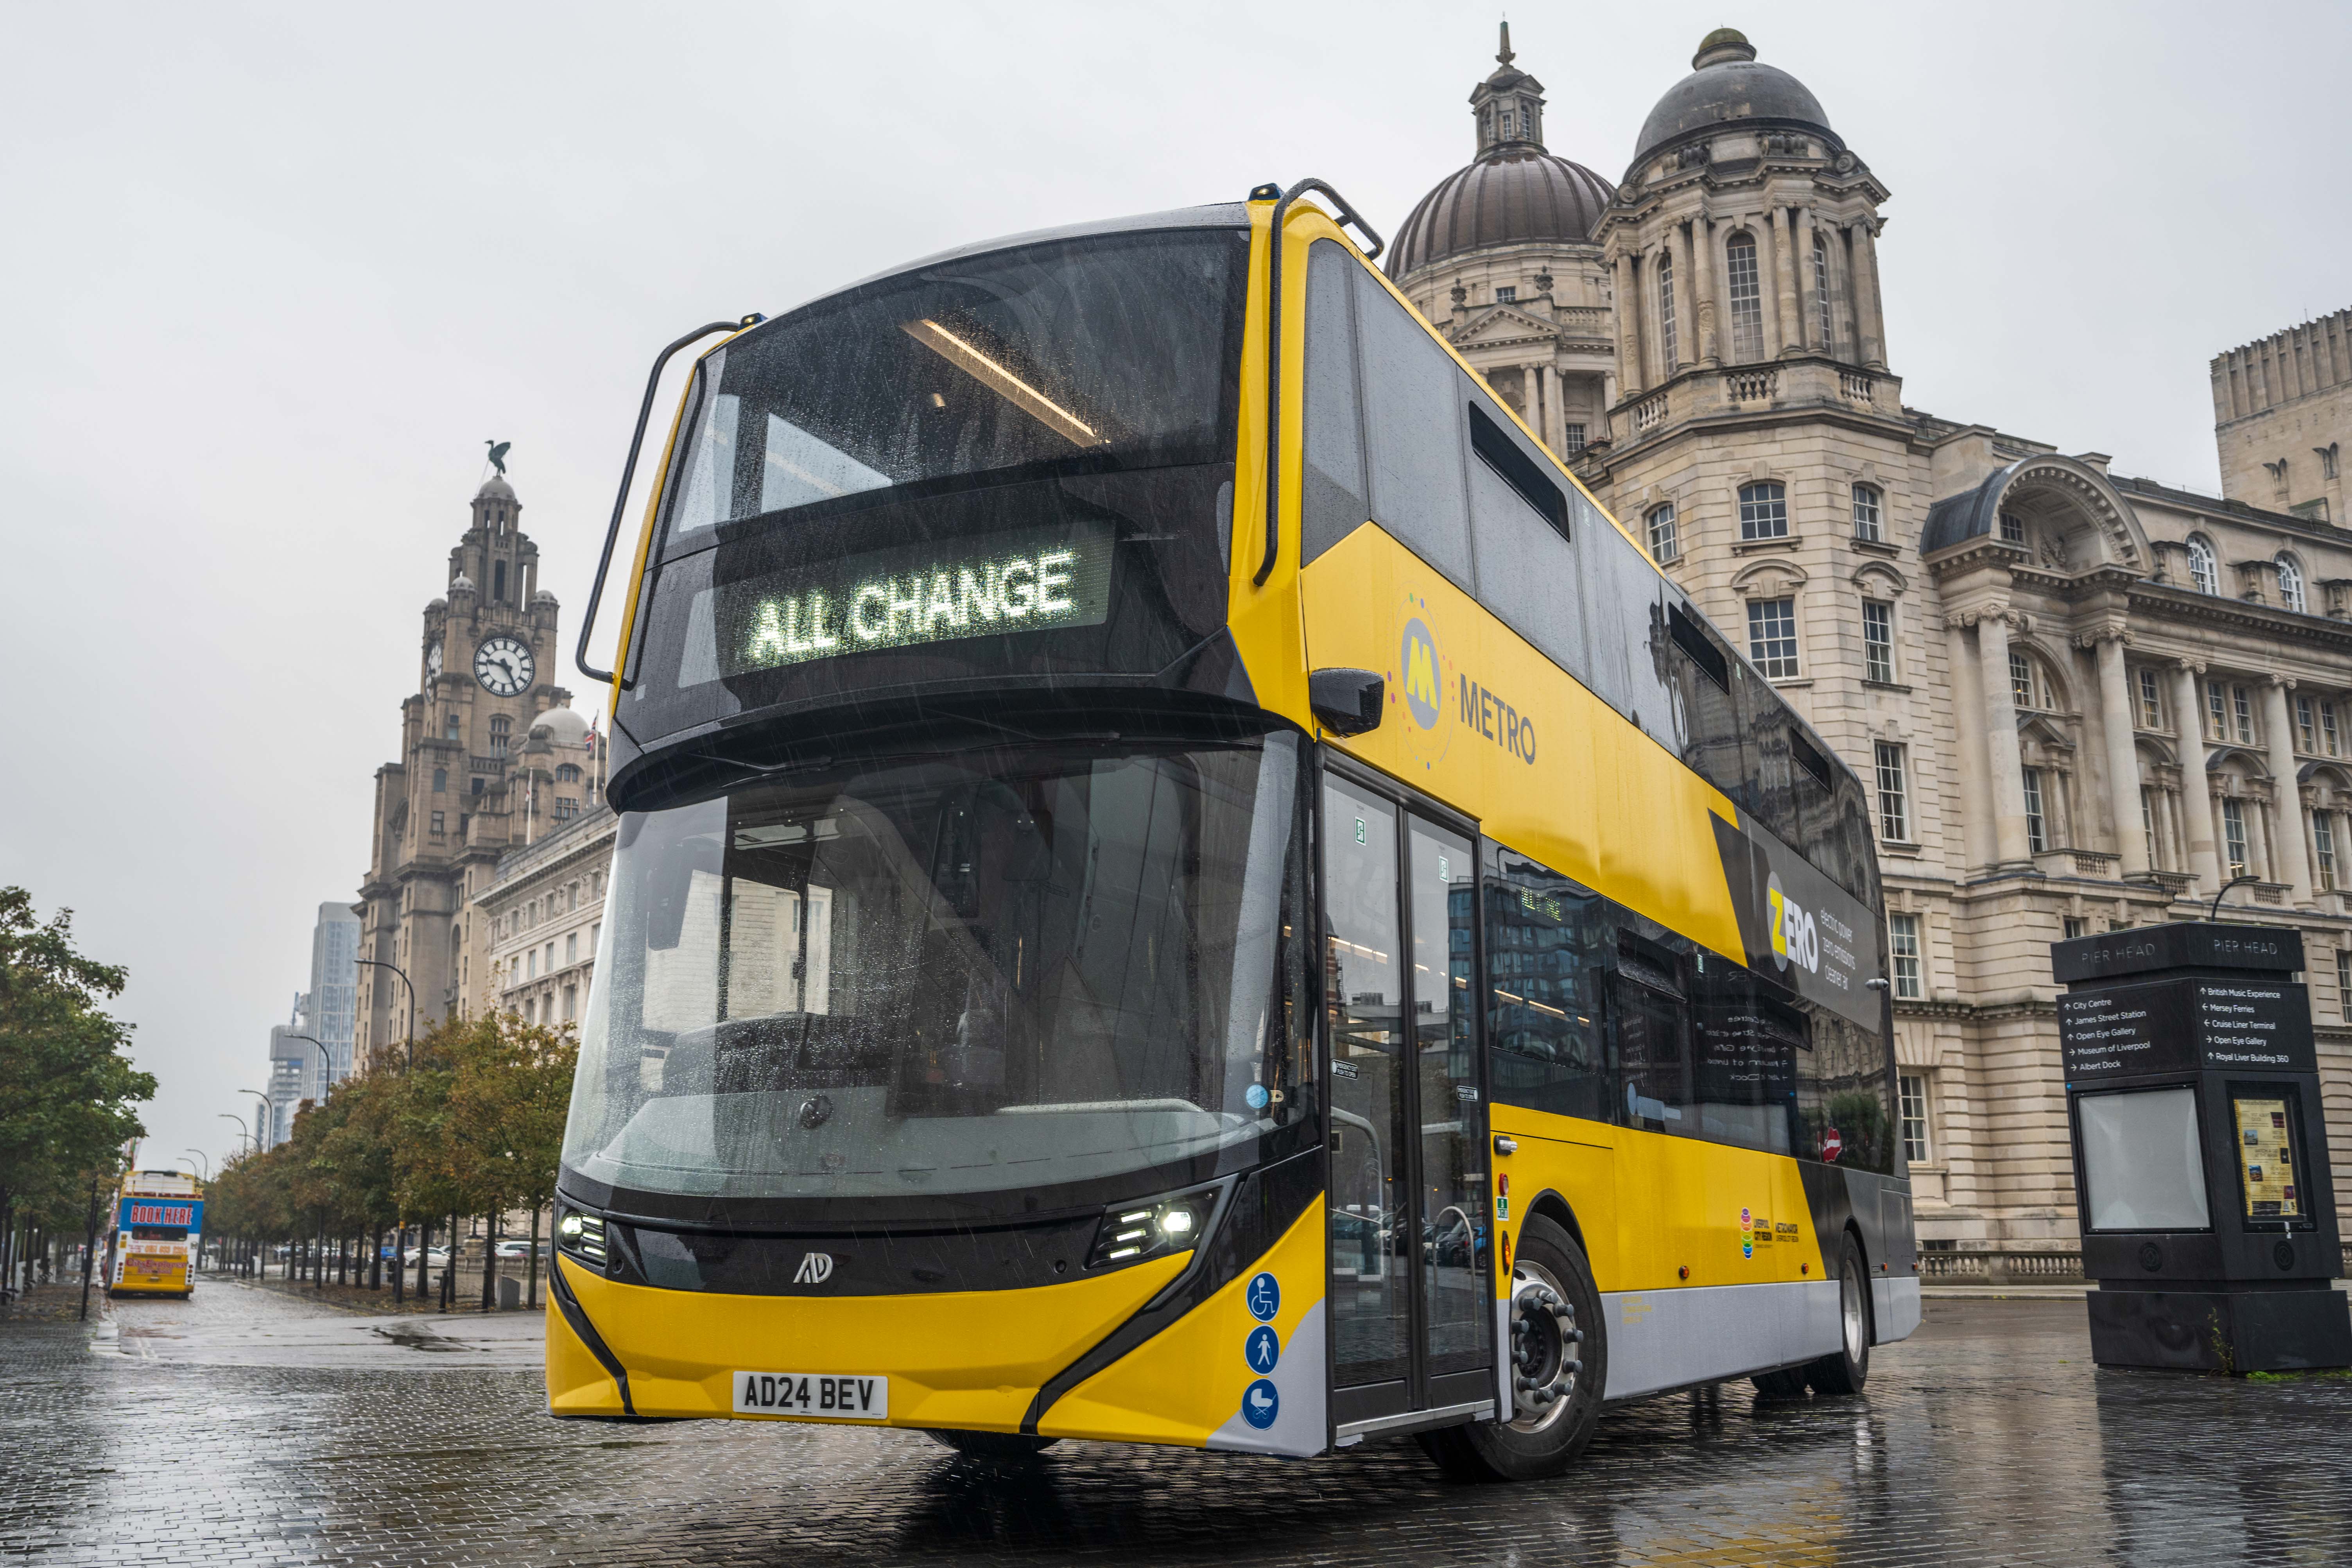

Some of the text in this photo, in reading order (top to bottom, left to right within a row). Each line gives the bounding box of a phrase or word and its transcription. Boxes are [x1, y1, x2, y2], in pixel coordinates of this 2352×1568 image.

[750, 549, 1074, 659] ALL CHANGE
[1406, 635, 1438, 711] M
[1460, 672, 1536, 765] METRO
[1769, 887, 1818, 974] ZERO
[2081, 943, 2155, 964] PIER HEAD
[2214, 939, 2278, 955] PIER HEAD
[2247, 990, 2280, 998] Experience
[2088, 999, 2112, 1007] Centre
[2210, 1004, 2232, 1013] Mersey
[2098, 1013, 2119, 1022] Street
[2121, 1011, 2146, 1019] Station
[2076, 1028, 2136, 1041] Open Eye Gallery
[2214, 1036, 2267, 1046] Open Eye Gallery
[2077, 1047, 2106, 1055] Museum
[2117, 1041, 2151, 1051] Liverpool
[2102, 1060, 2121, 1069] Dock
[2216, 1052, 2234, 1061] Royal
[2250, 1054, 2276, 1063] Building
[131, 1205, 193, 1225] BOOK HERE
[744, 1376, 874, 1410] AD24 BEV
